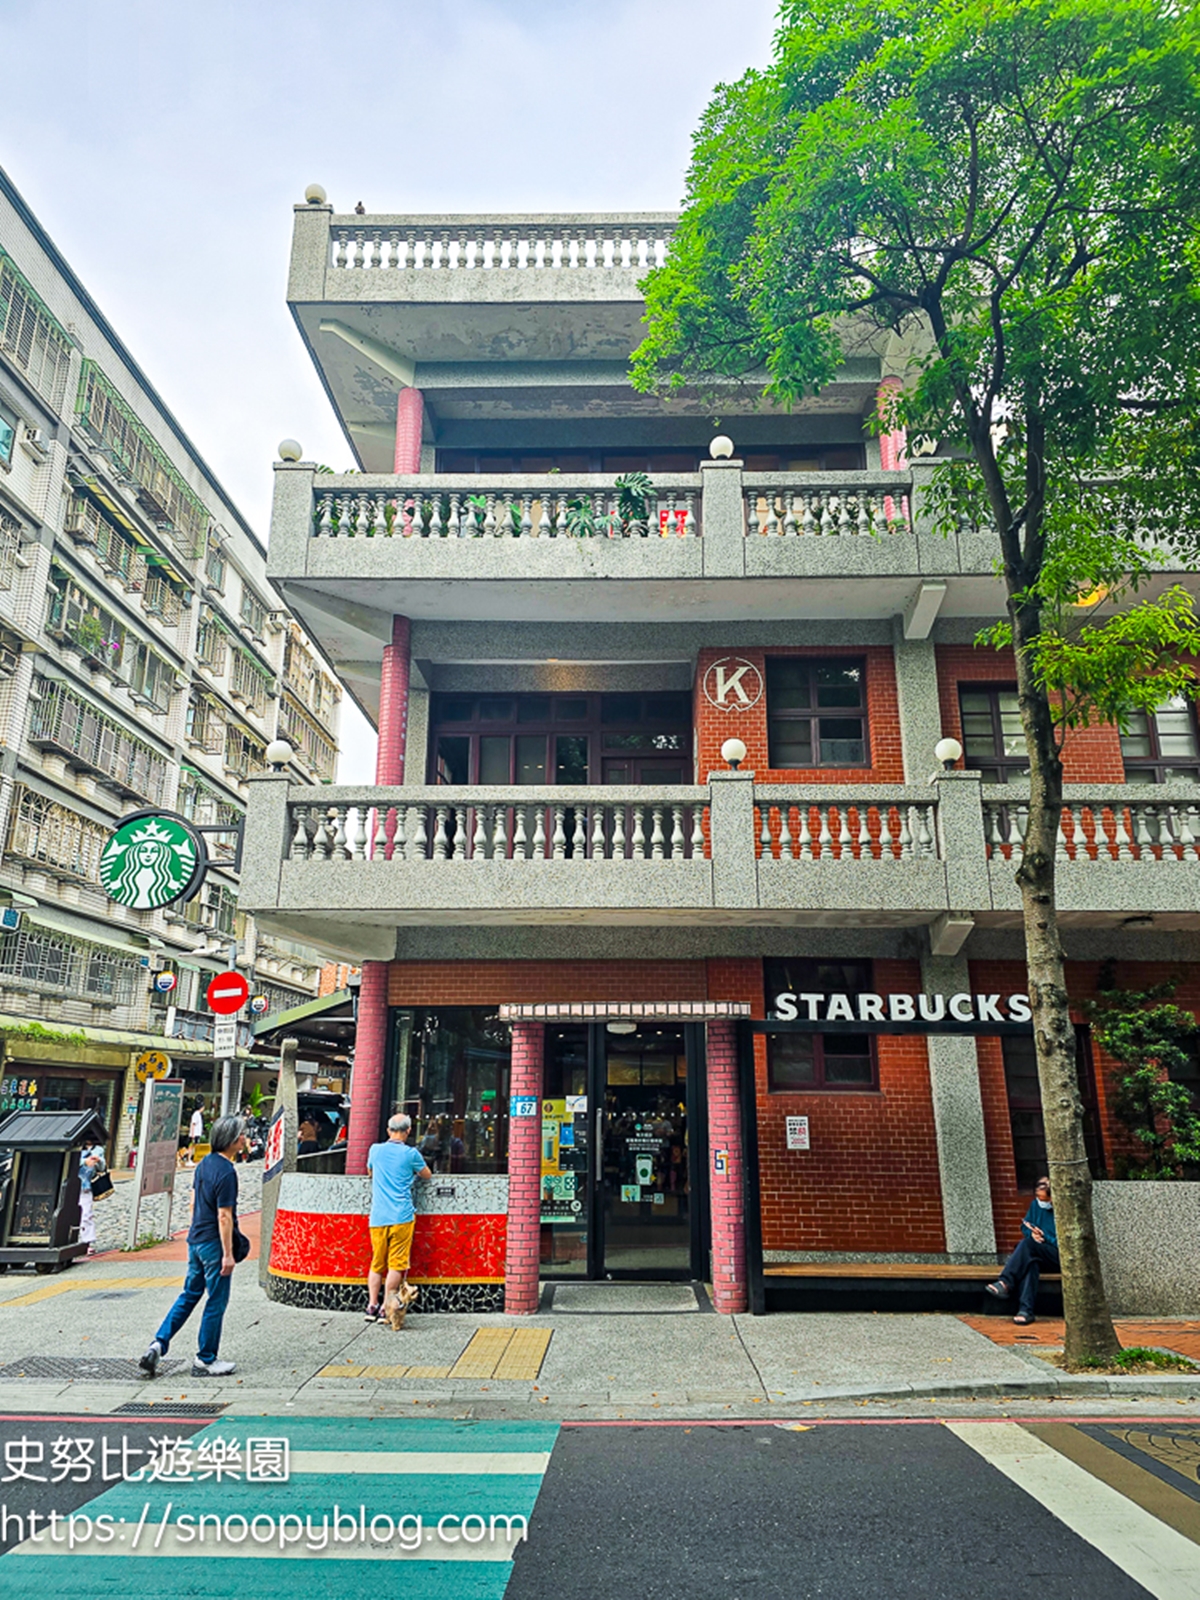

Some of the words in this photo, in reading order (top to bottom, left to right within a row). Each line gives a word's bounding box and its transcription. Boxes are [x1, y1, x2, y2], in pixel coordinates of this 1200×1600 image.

[713, 666, 752, 704] K
[775, 993, 1033, 1022] STARBUCKS
[520, 1103, 534, 1114] 67
